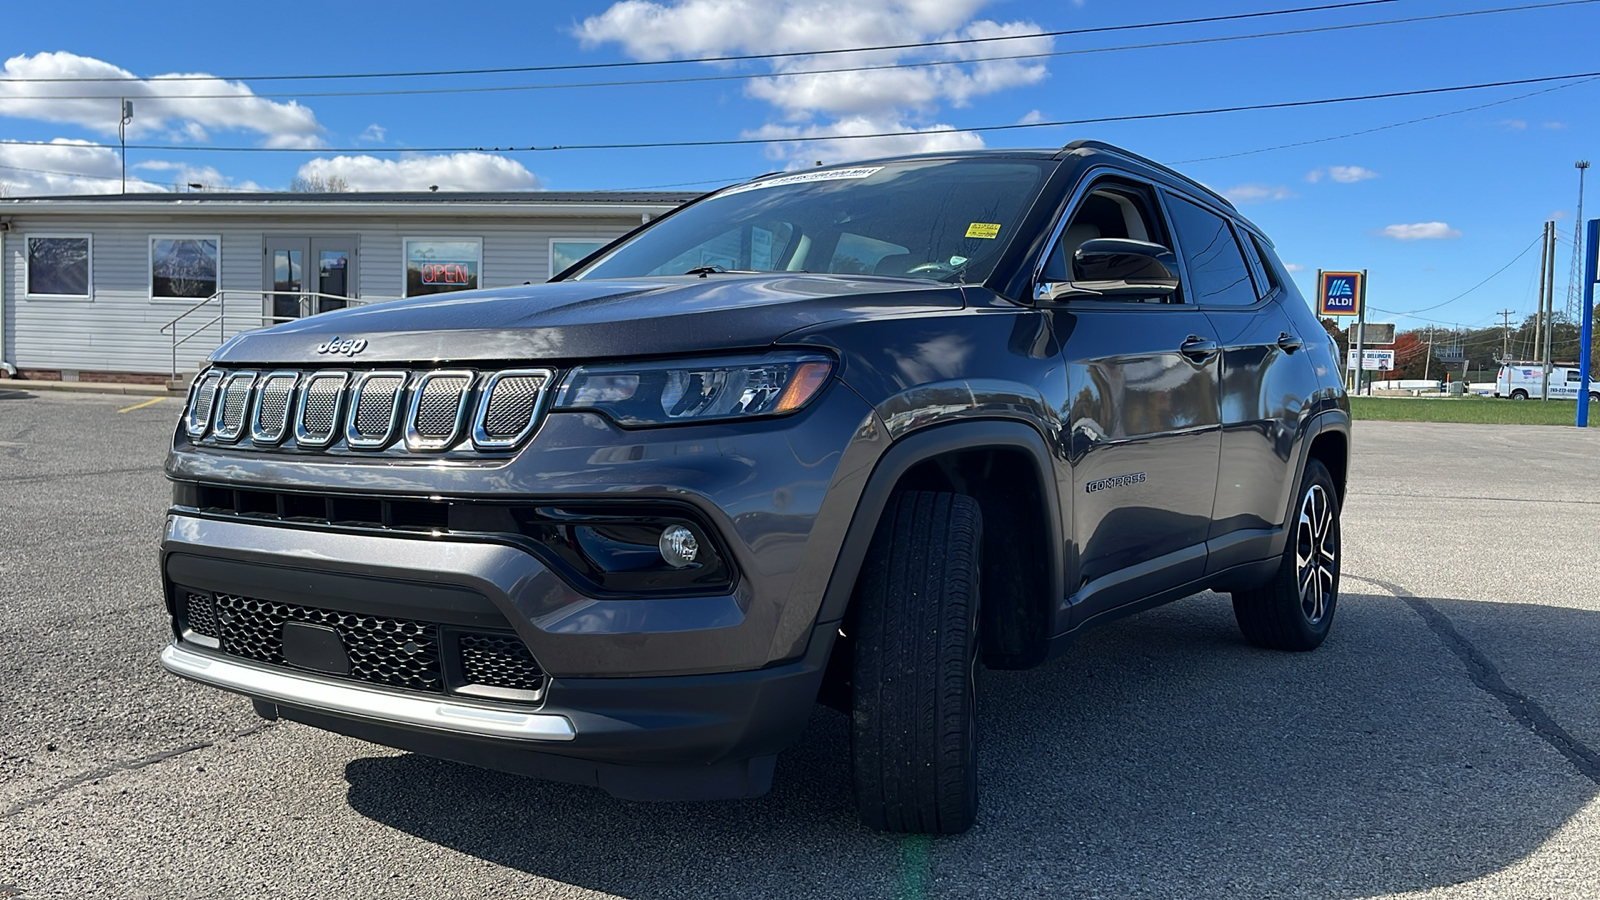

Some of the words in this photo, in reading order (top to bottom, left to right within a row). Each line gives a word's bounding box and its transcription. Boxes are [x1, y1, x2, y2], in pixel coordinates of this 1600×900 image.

[423, 264, 467, 283] OPEN
[1327, 298, 1352, 306] ALDI
[317, 336, 368, 357] Jeep
[1086, 472, 1147, 493] COMPASS
